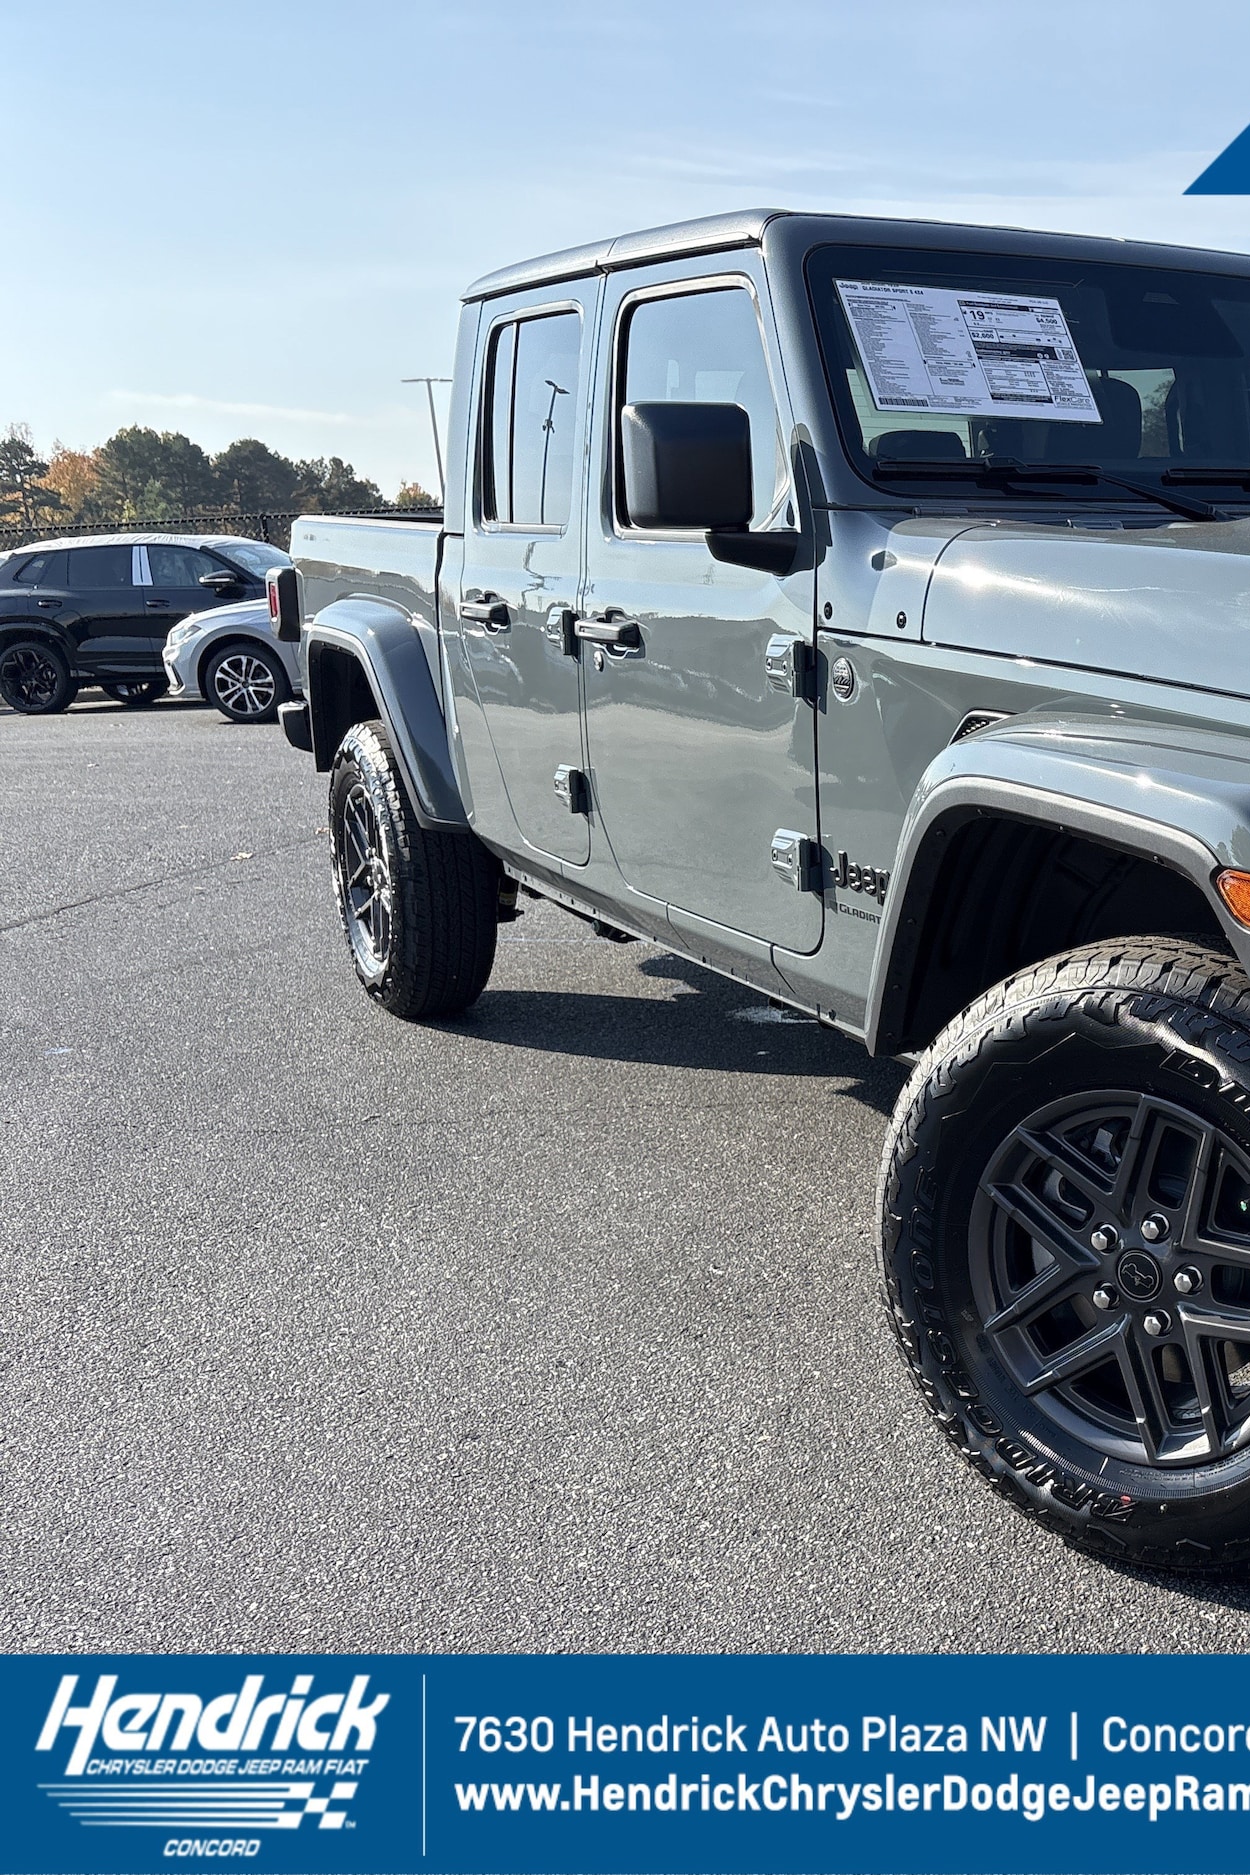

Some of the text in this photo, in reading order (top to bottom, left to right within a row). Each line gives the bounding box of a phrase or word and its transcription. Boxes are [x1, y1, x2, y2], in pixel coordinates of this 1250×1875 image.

[862, 285, 892, 293] GLADIATOR
[969, 310, 986, 320] 19
[1054, 395, 1091, 404] FlexCare
[829, 850, 891, 906] Jeep
[839, 903, 882, 925] GLADIAT
[907, 1165, 1139, 1524] BRIDGESTONE
